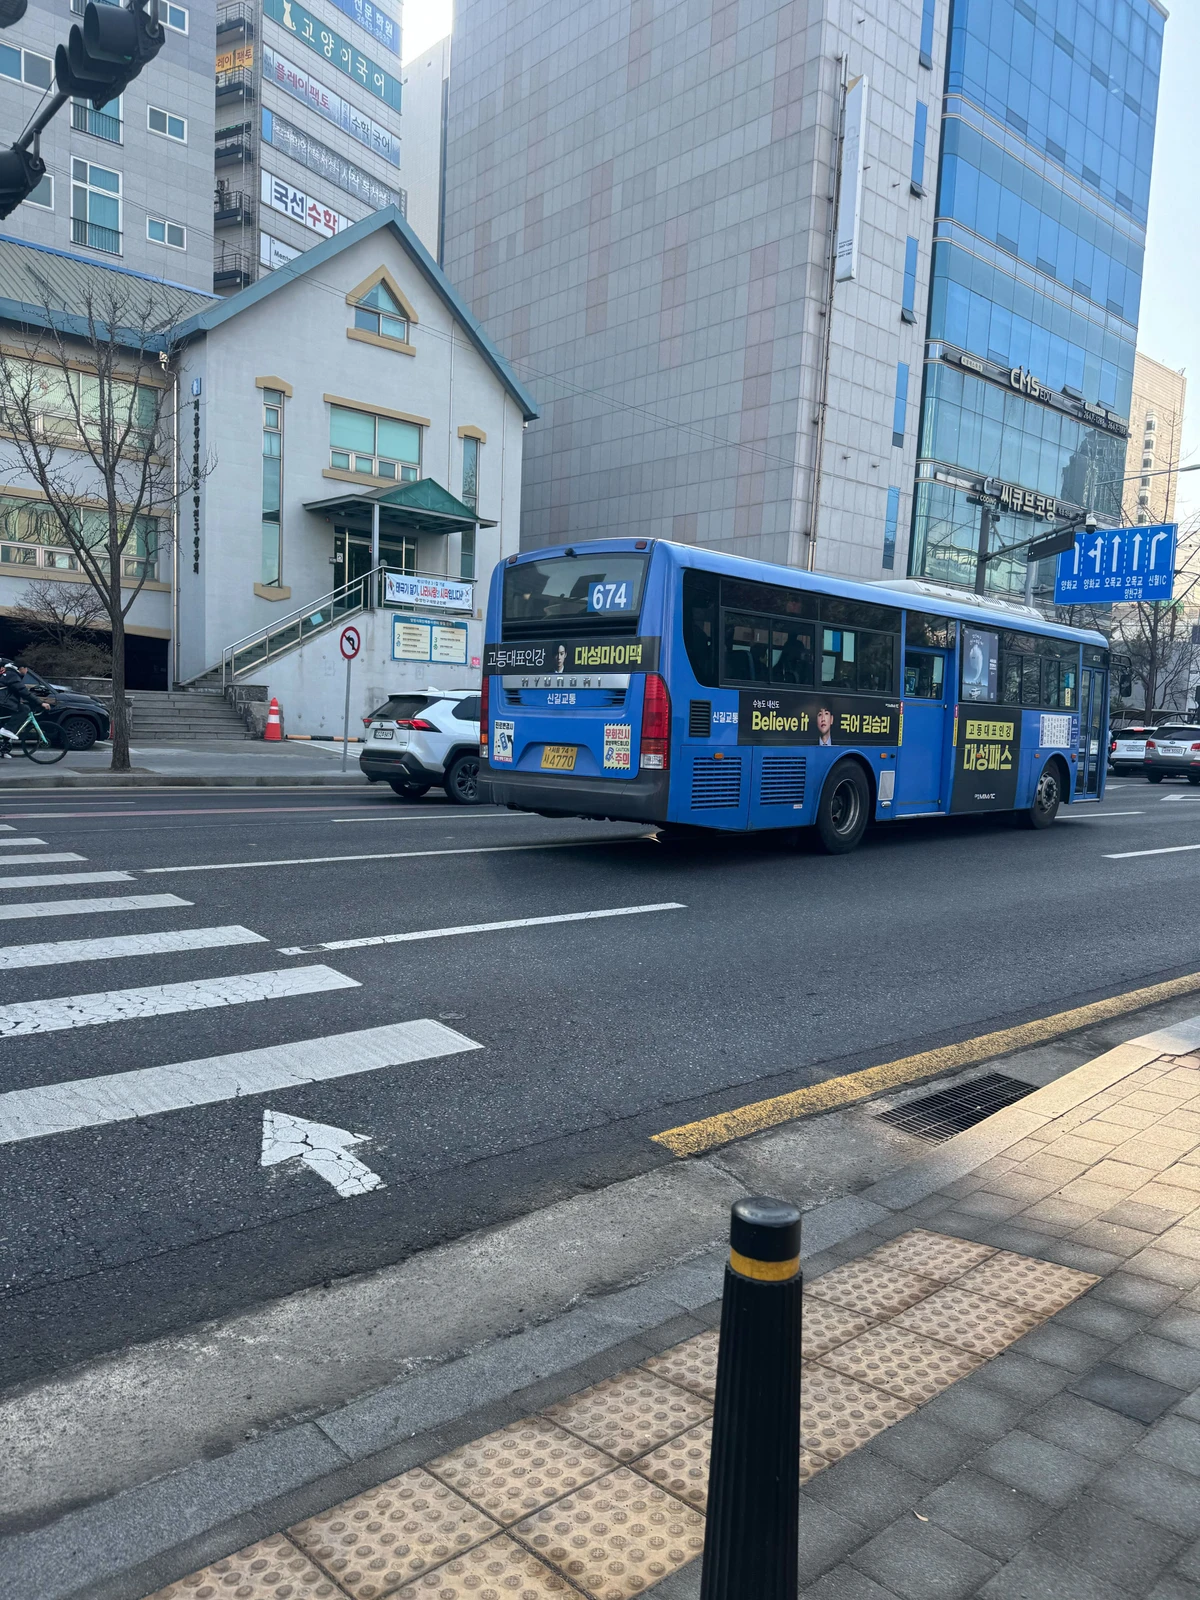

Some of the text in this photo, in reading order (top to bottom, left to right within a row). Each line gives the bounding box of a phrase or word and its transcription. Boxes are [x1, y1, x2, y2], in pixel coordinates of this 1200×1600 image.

[216, 54, 232, 69] 레이
[351, 116, 390, 153] 수학 국어
[1010, 367, 1040, 397] CMS
[1000, 485, 1057, 521] 씨큐브코딩
[1061, 580, 1078, 591] 양화교
[1083, 579, 1101, 590] 양화교
[1104, 577, 1122, 588] 오목교
[1125, 576, 1144, 587] 오목교
[592, 582, 628, 610] 674
[487, 644, 642, 668] 고등대표인강 대성마이맥
[547, 693, 577, 705] 신길교통
[712, 711, 739, 724] 신길교통
[752, 711, 810, 732] Believe it
[840, 713, 860, 733] 국어
[862, 716, 891, 734] 김승리
[549, 754, 574, 767] 4770
[963, 743, 1013, 771] 대성패스
